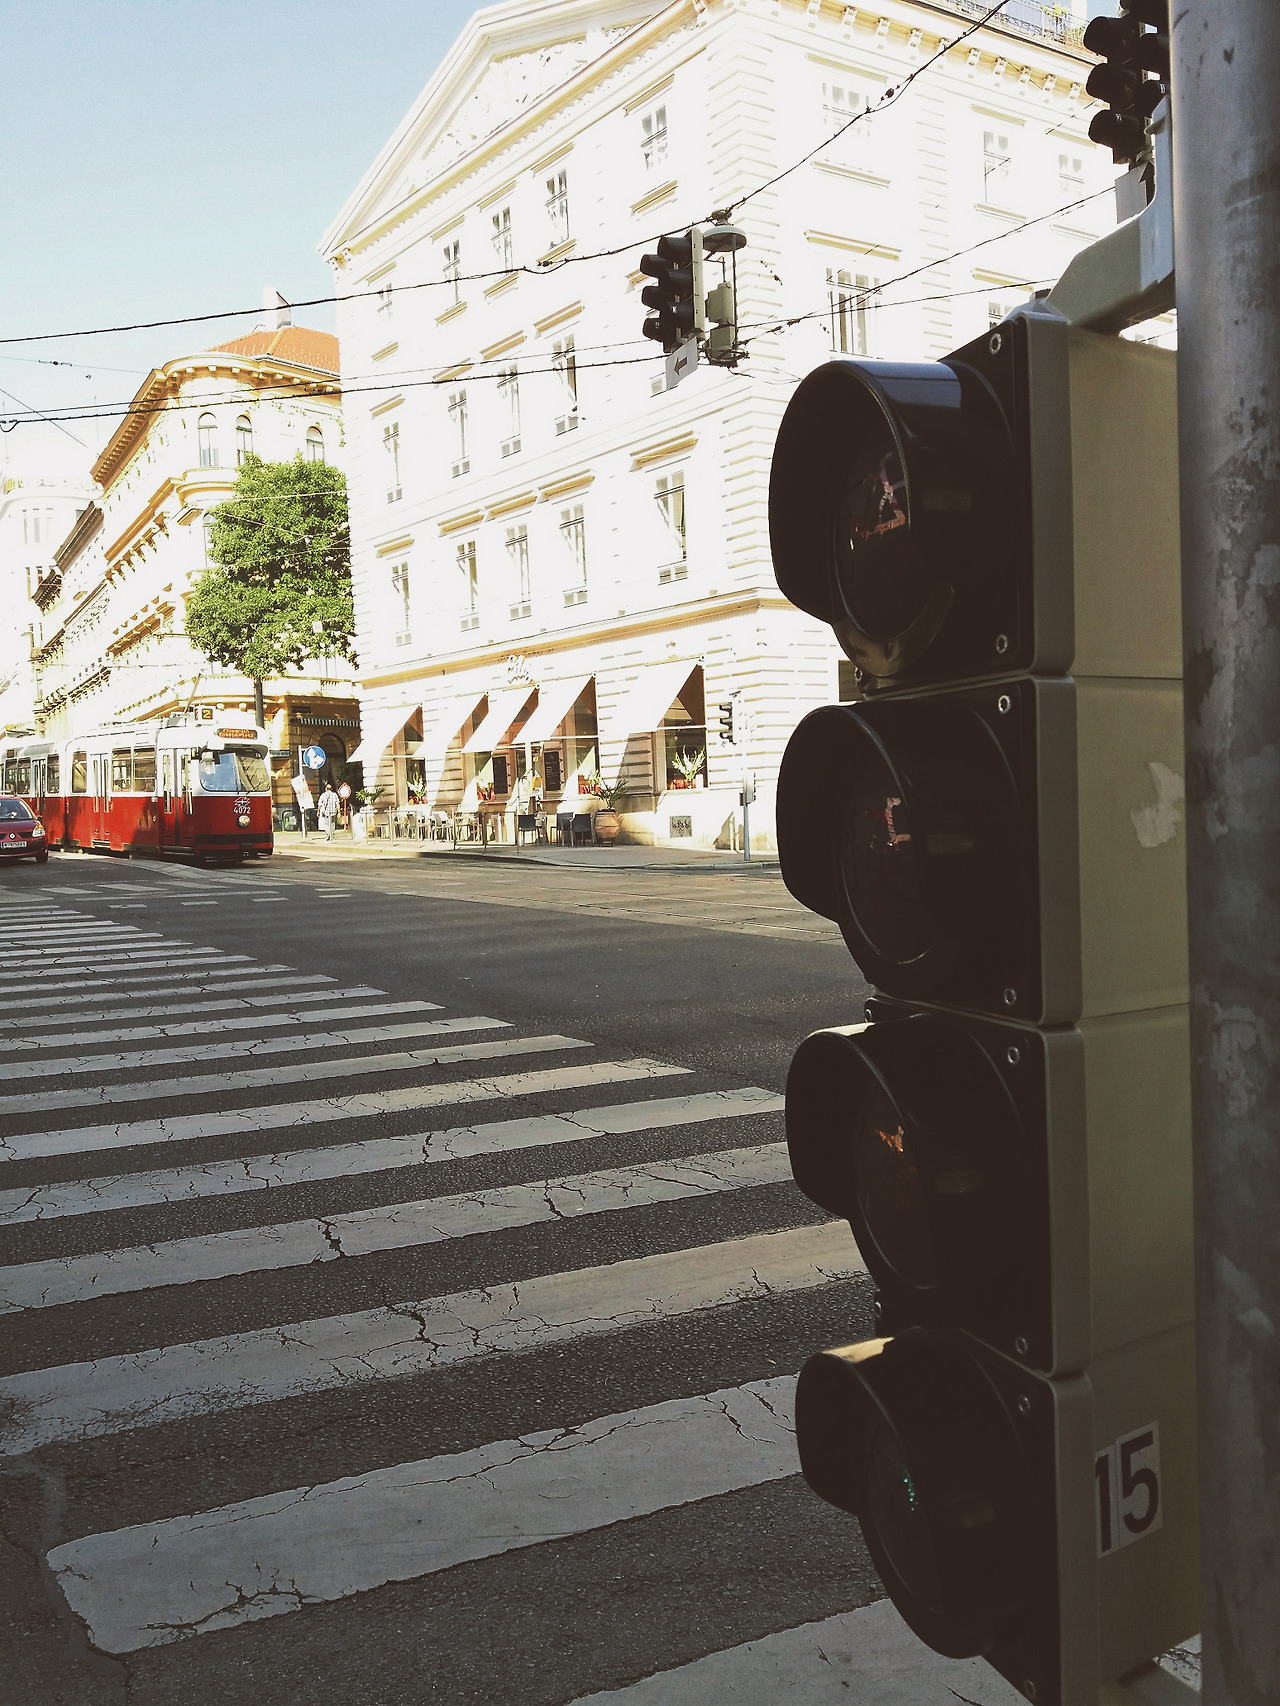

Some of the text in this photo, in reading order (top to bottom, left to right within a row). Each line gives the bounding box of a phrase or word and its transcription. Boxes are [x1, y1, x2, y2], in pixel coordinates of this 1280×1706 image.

[202, 709, 211, 719] 2
[233, 806, 251, 814] 4072
[1095, 1430, 1159, 1552] 15
